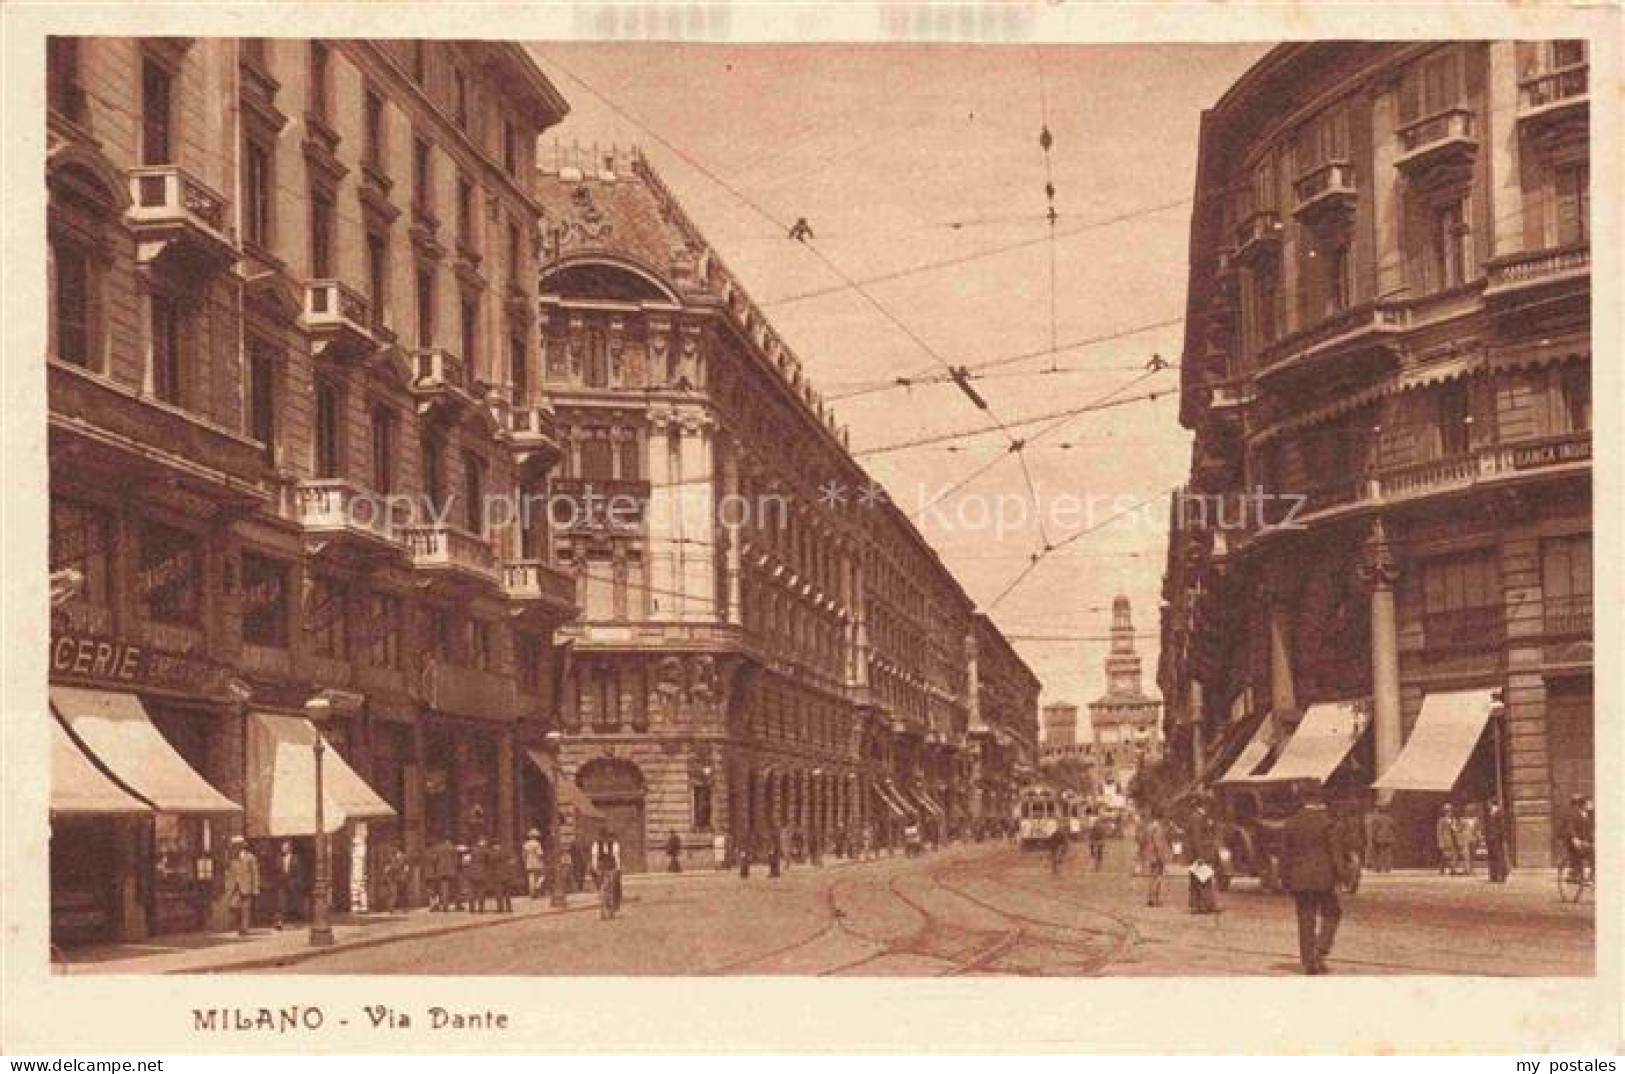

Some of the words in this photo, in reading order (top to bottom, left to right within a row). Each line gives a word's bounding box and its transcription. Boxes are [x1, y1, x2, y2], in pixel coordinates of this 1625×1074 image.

[50, 636, 139, 679] CERIE
[193, 1005, 324, 1034] MILANO
[364, 1005, 411, 1029] Via
[428, 1007, 509, 1030] Dante
